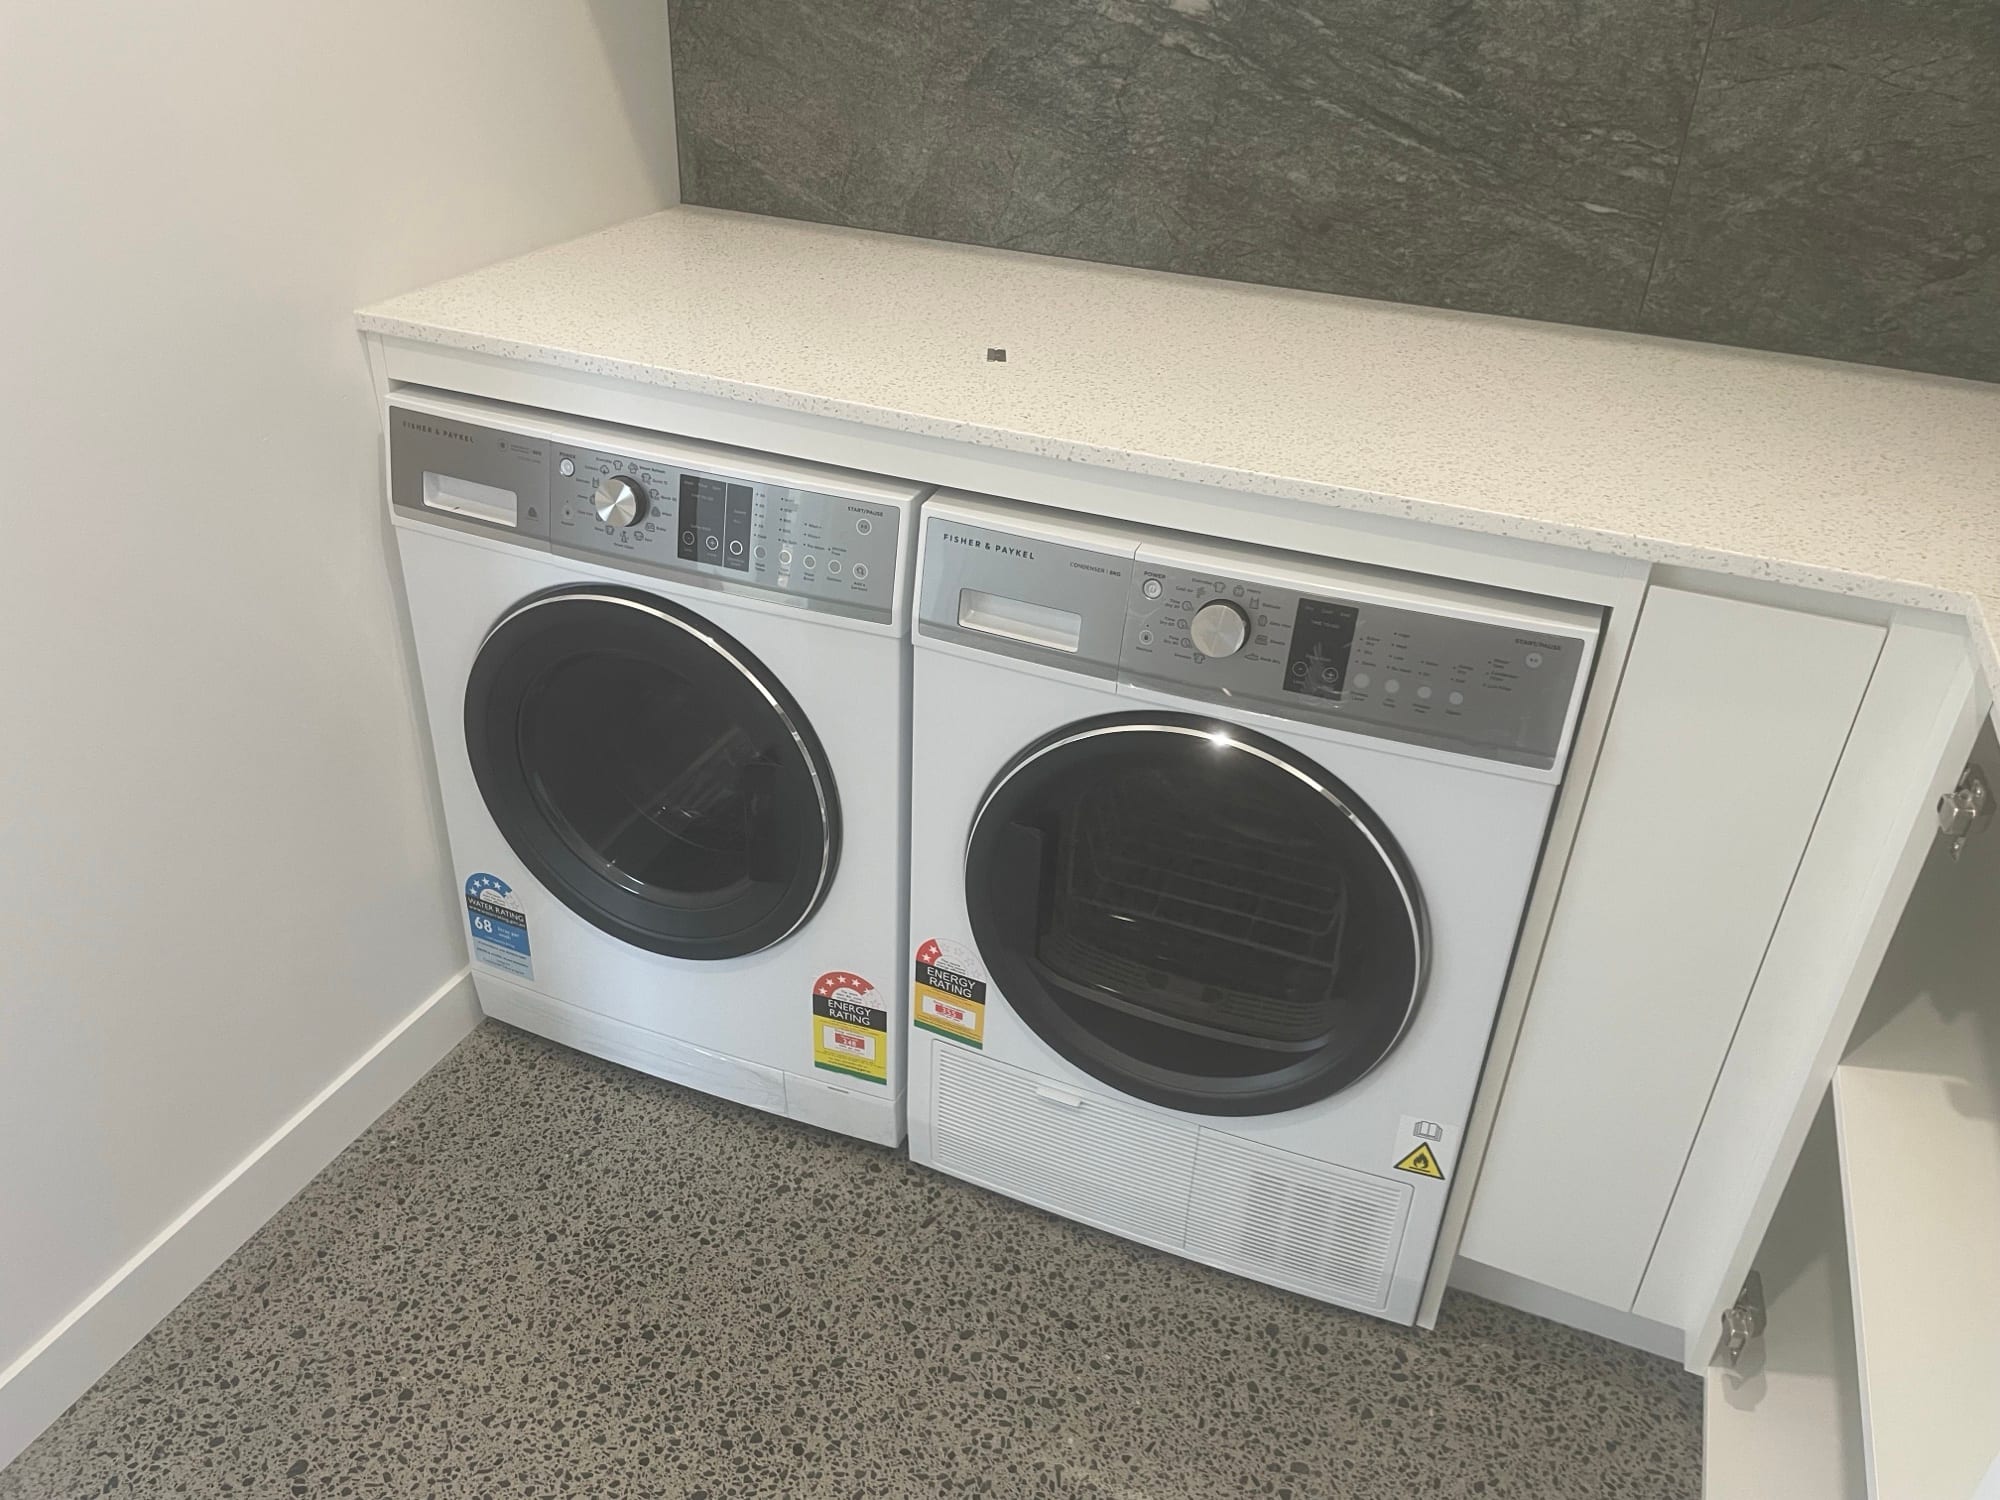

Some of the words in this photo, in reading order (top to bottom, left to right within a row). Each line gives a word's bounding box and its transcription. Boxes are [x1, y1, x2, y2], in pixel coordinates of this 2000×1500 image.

[402, 420, 432, 433] FISHER
[443, 430, 475, 444] PAYKEL
[848, 506, 883, 517] START/PAUSE
[943, 533, 981, 549] FISHER
[995, 545, 1036, 560] PAYKEL
[1144, 570, 1166, 579] POWER
[467, 897, 494, 911] WATER
[495, 906, 526, 923] RATING
[475, 916, 492, 933] 68
[927, 966, 976, 990] ENERGY
[929, 976, 972, 998] RATING
[827, 999, 871, 1017] ENERGY
[829, 1008, 871, 1026] RATING
